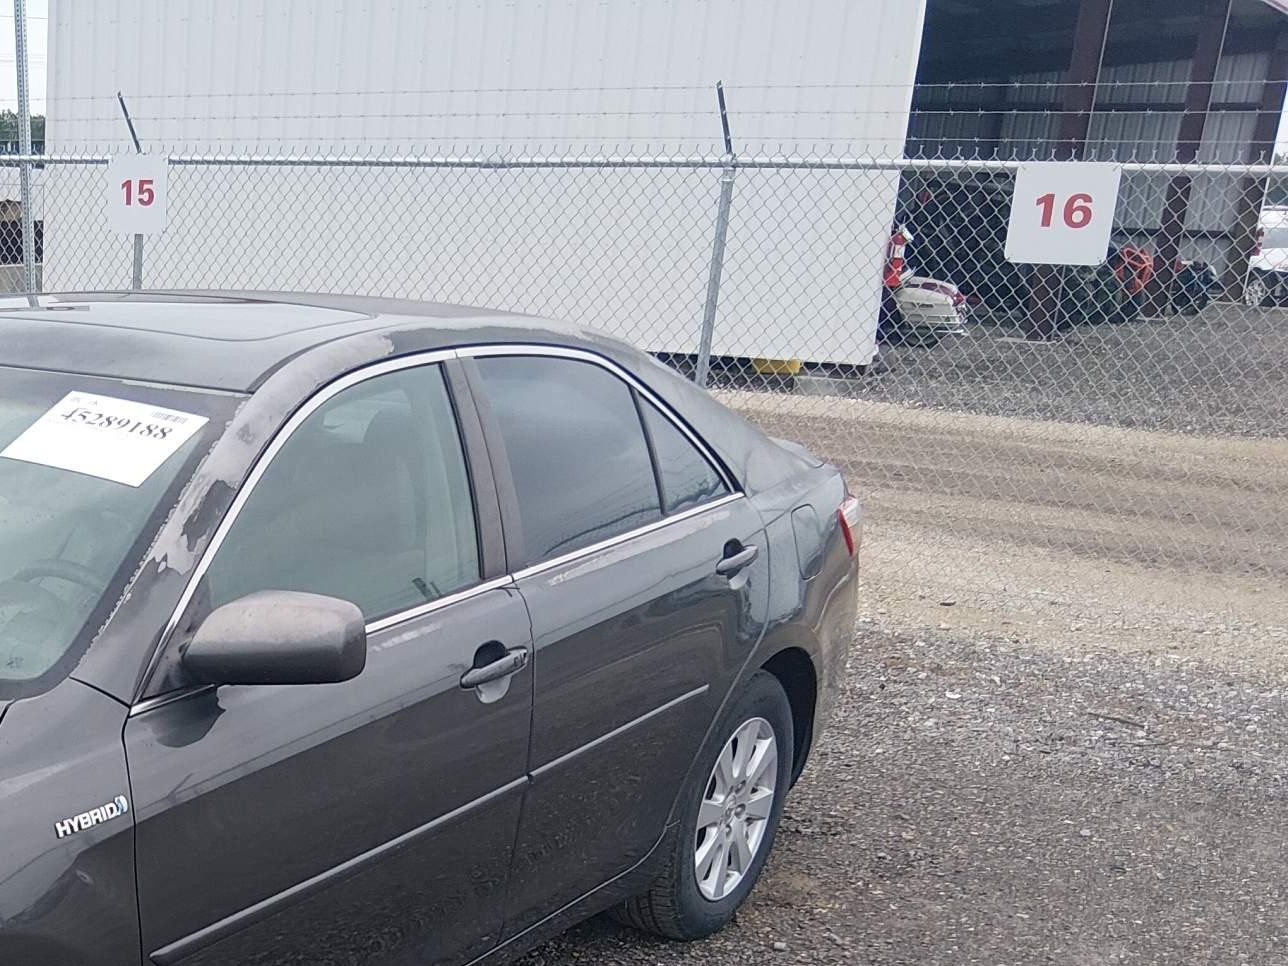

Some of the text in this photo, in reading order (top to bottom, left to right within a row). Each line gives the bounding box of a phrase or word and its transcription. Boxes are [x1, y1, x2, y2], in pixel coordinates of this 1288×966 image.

[121, 179, 155, 206] 15
[1035, 193, 1094, 229] 16
[60, 407, 173, 440] 45289188
[54, 802, 118, 839] HYBRID
